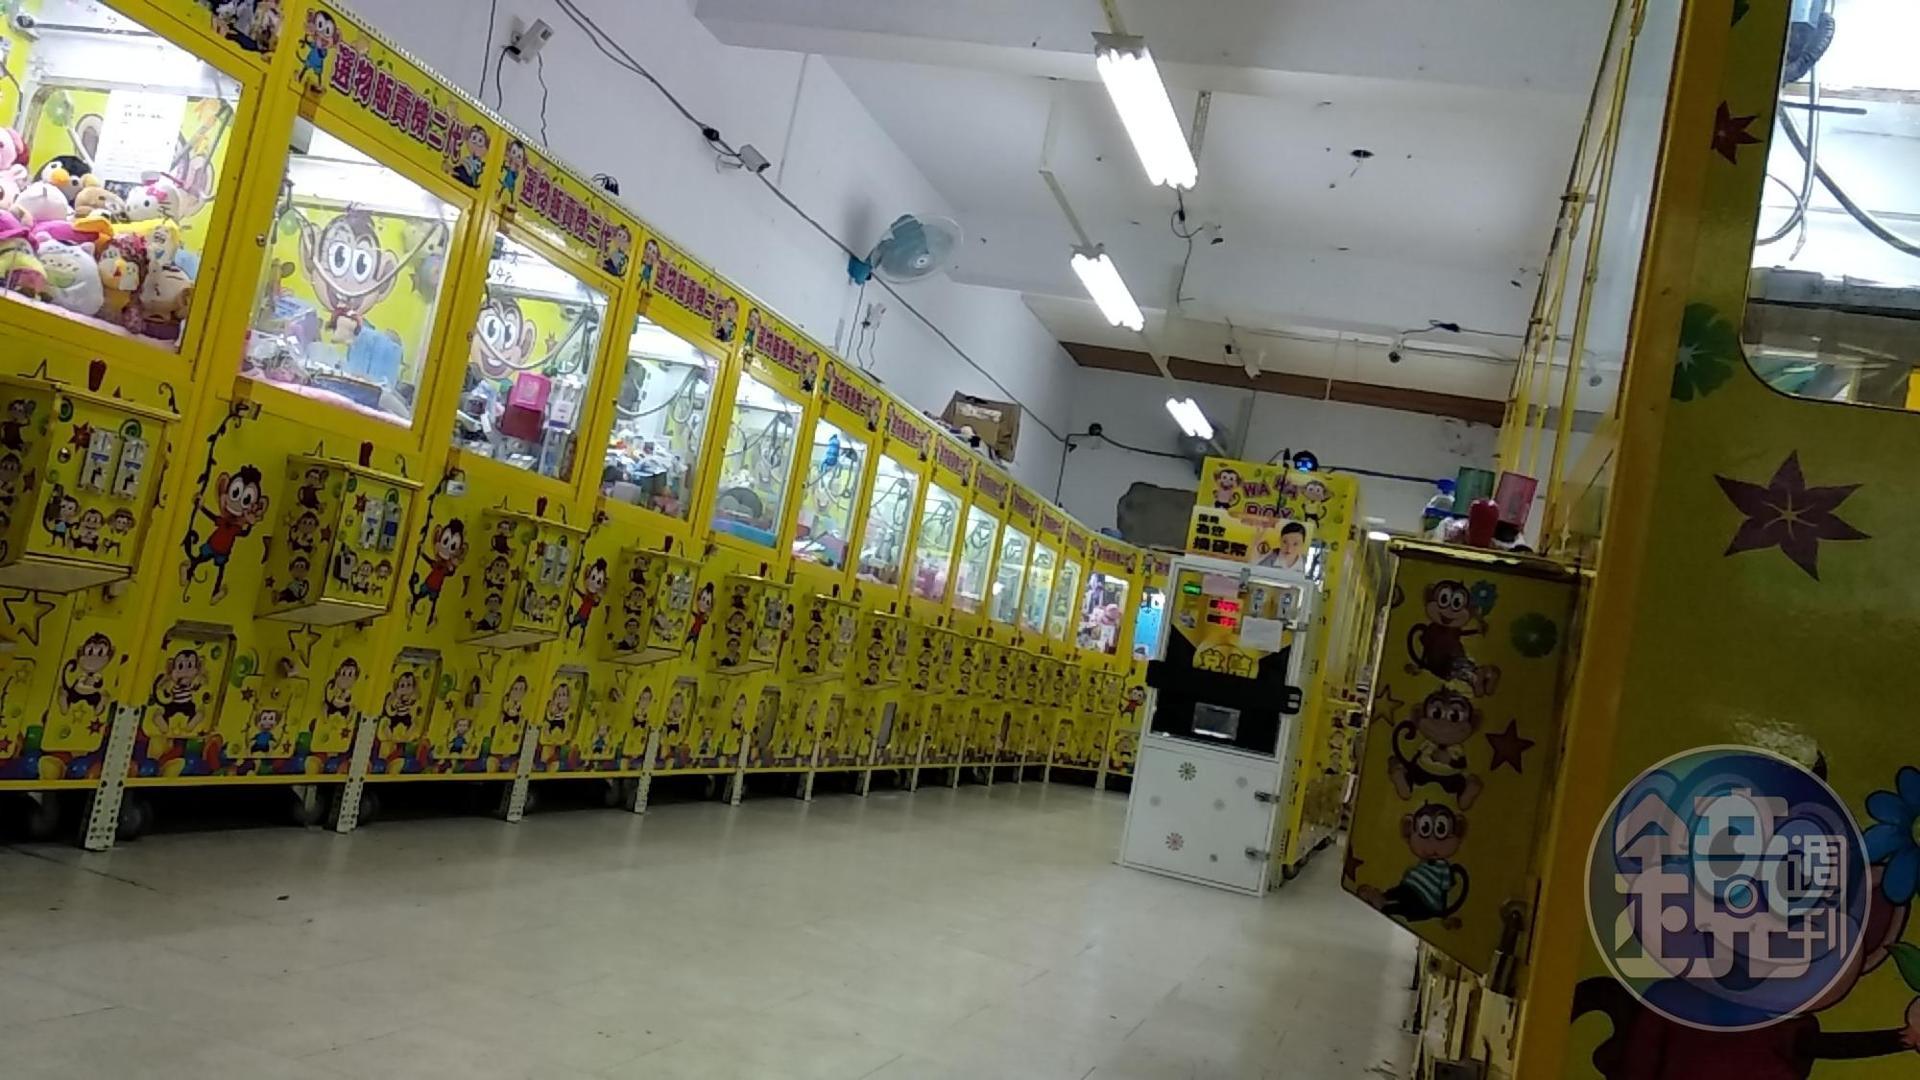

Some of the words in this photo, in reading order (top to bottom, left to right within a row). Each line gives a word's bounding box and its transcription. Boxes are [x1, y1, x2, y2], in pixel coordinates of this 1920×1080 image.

[330, 41, 466, 164] 選物販賣機二代
